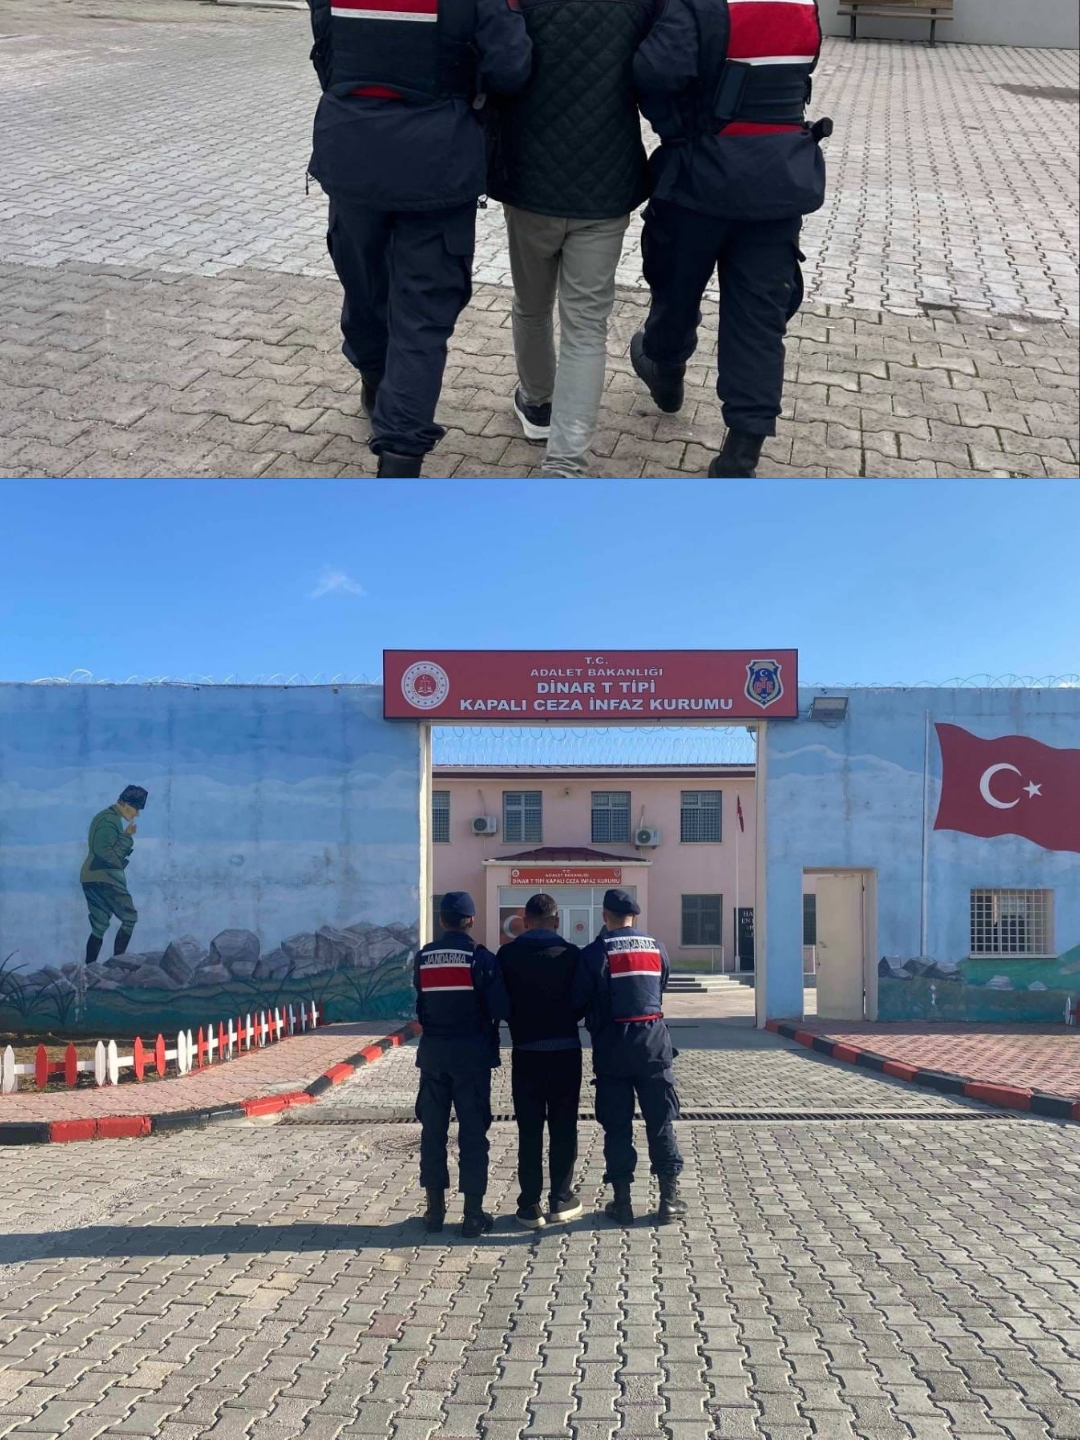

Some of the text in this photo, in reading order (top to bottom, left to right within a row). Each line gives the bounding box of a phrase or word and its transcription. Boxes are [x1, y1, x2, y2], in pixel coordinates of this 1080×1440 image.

[585, 656, 608, 664] T.C.
[530, 666, 663, 676] ADALET BAKANLIĞI
[538, 680, 655, 694] DİNAR T TİPİ
[460, 696, 733, 710] KAPALI CEZA İNFAZ KURUMU
[612, 940, 656, 951] JANDARMA
[424, 954, 466, 964] JANDARMA
